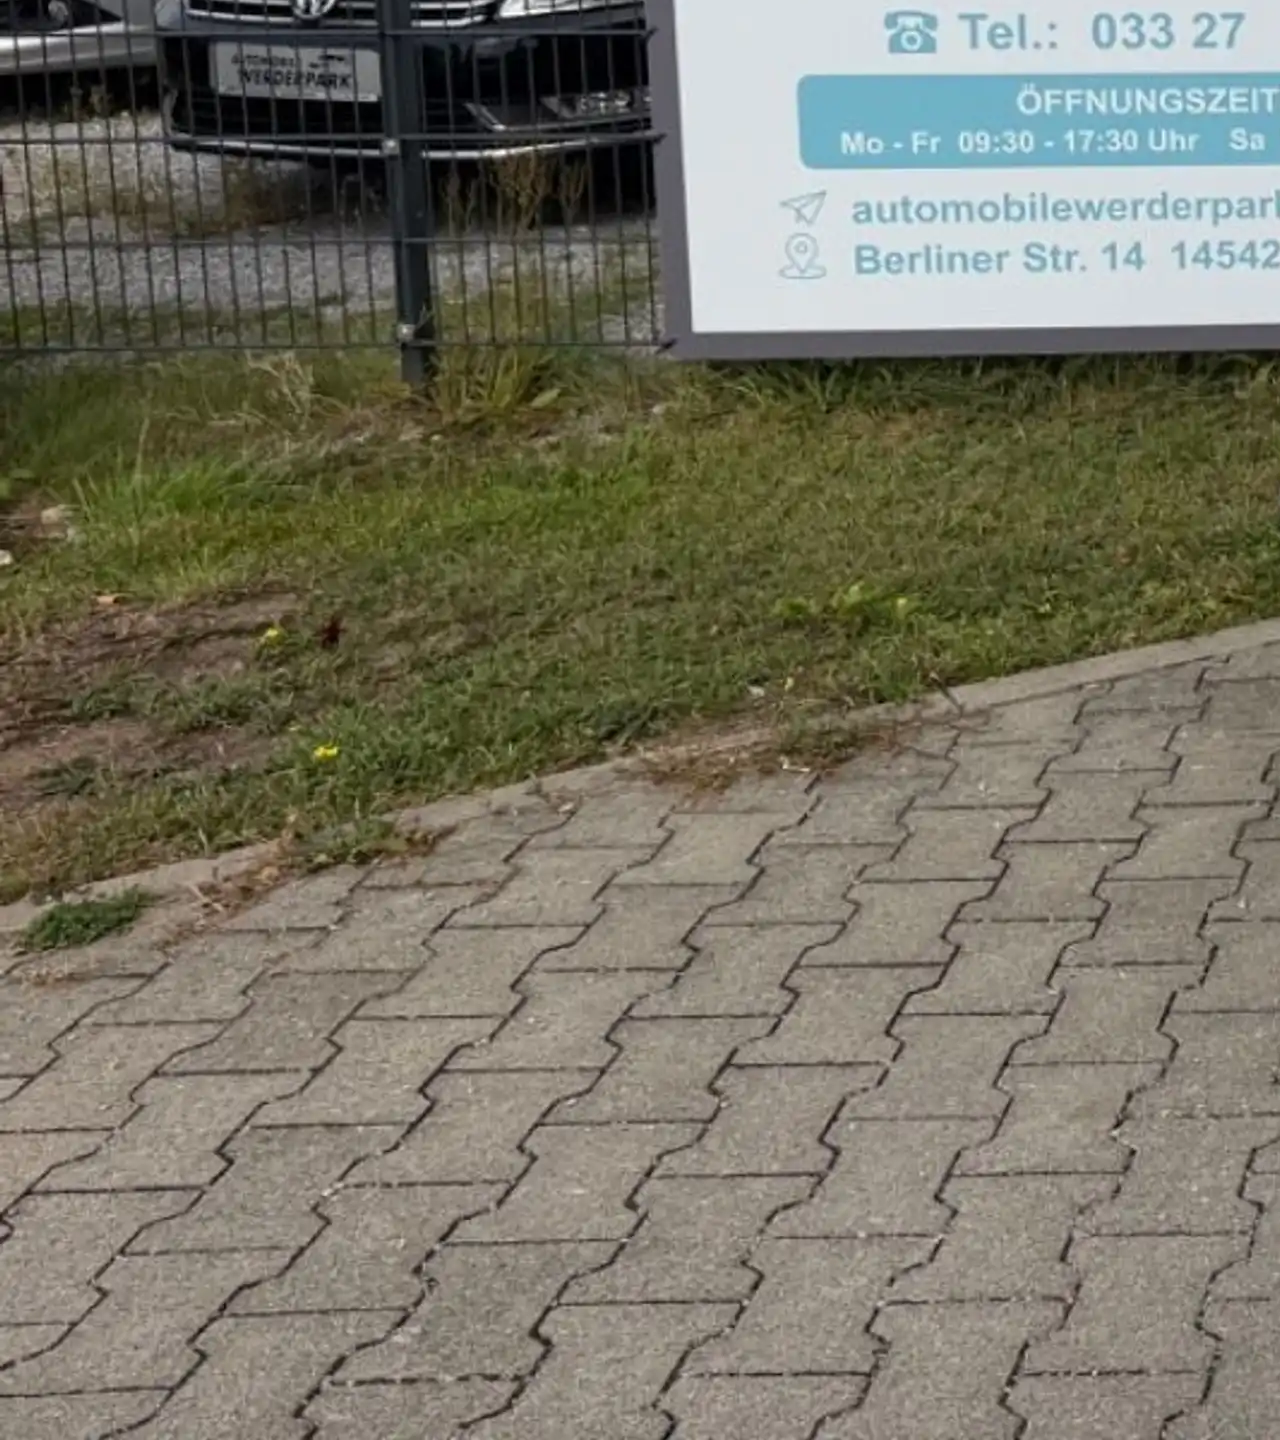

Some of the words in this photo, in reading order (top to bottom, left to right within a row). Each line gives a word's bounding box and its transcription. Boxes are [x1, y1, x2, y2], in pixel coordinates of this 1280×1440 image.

[957, 13, 1058, 50] Tel.:
[1091, 12, 1175, 50] 033
[1192, 11, 1246, 50] 27
[841, 131, 884, 154] Mo
[912, 131, 942, 154] Fr
[957, 130, 1035, 154] 09:30
[1063, 129, 1139, 153] 17:30
[1149, 128, 1200, 152] Uhr
[1228, 127, 1266, 151] Sa
[855, 244, 1010, 275] Berliner
[1023, 242, 1087, 273] Str.
[1102, 241, 1146, 271] 14
